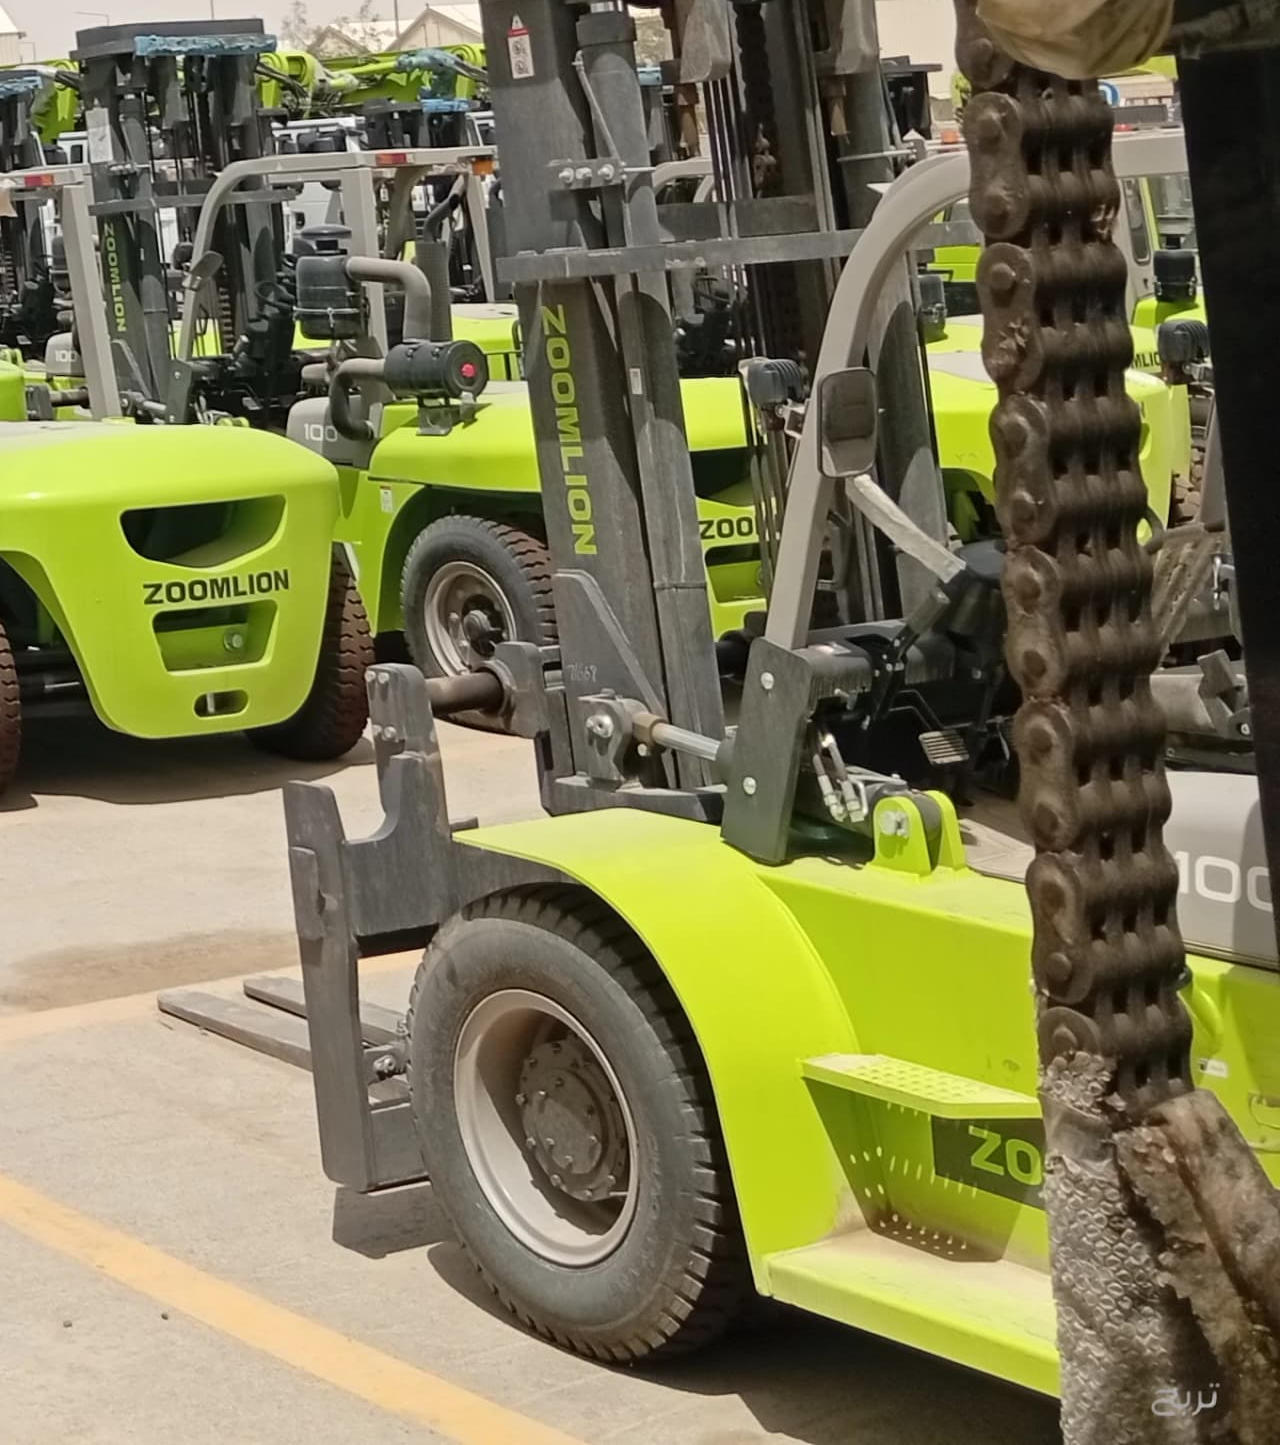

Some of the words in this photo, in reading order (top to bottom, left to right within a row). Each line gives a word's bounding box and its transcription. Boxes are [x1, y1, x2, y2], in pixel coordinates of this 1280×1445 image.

[103, 222, 127, 332] ZOOMLION
[304, 423, 338, 442] 100
[541, 304, 598, 555] ZOOMLION
[143, 569, 290, 605] ZOOMLION
